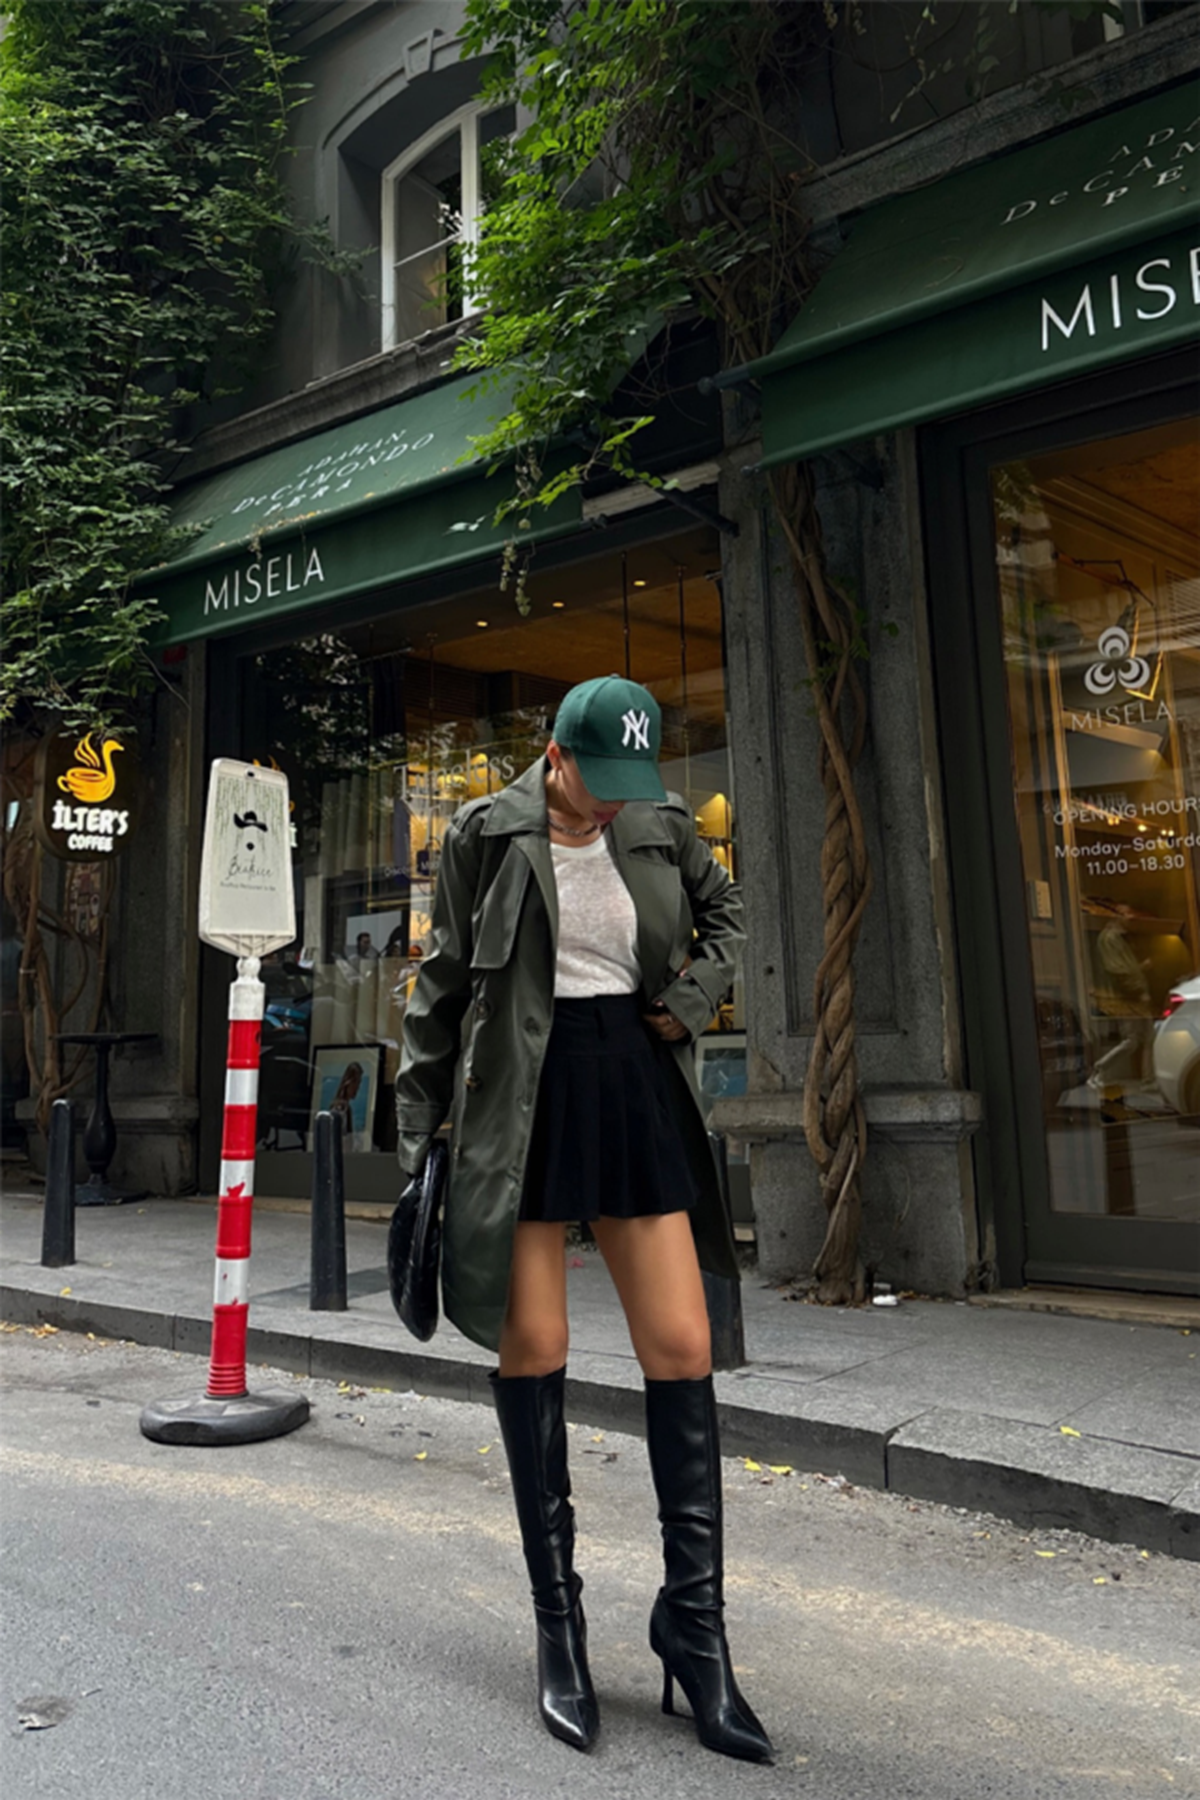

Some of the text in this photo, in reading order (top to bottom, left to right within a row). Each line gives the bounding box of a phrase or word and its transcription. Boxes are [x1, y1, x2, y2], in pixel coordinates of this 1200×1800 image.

[203, 547, 325, 616] MISELA
[621, 708, 650, 750] NY
[1071, 699, 1173, 732] MISELA
[1053, 803, 1138, 826] OPENING
[67, 833, 114, 852] COFFEE
